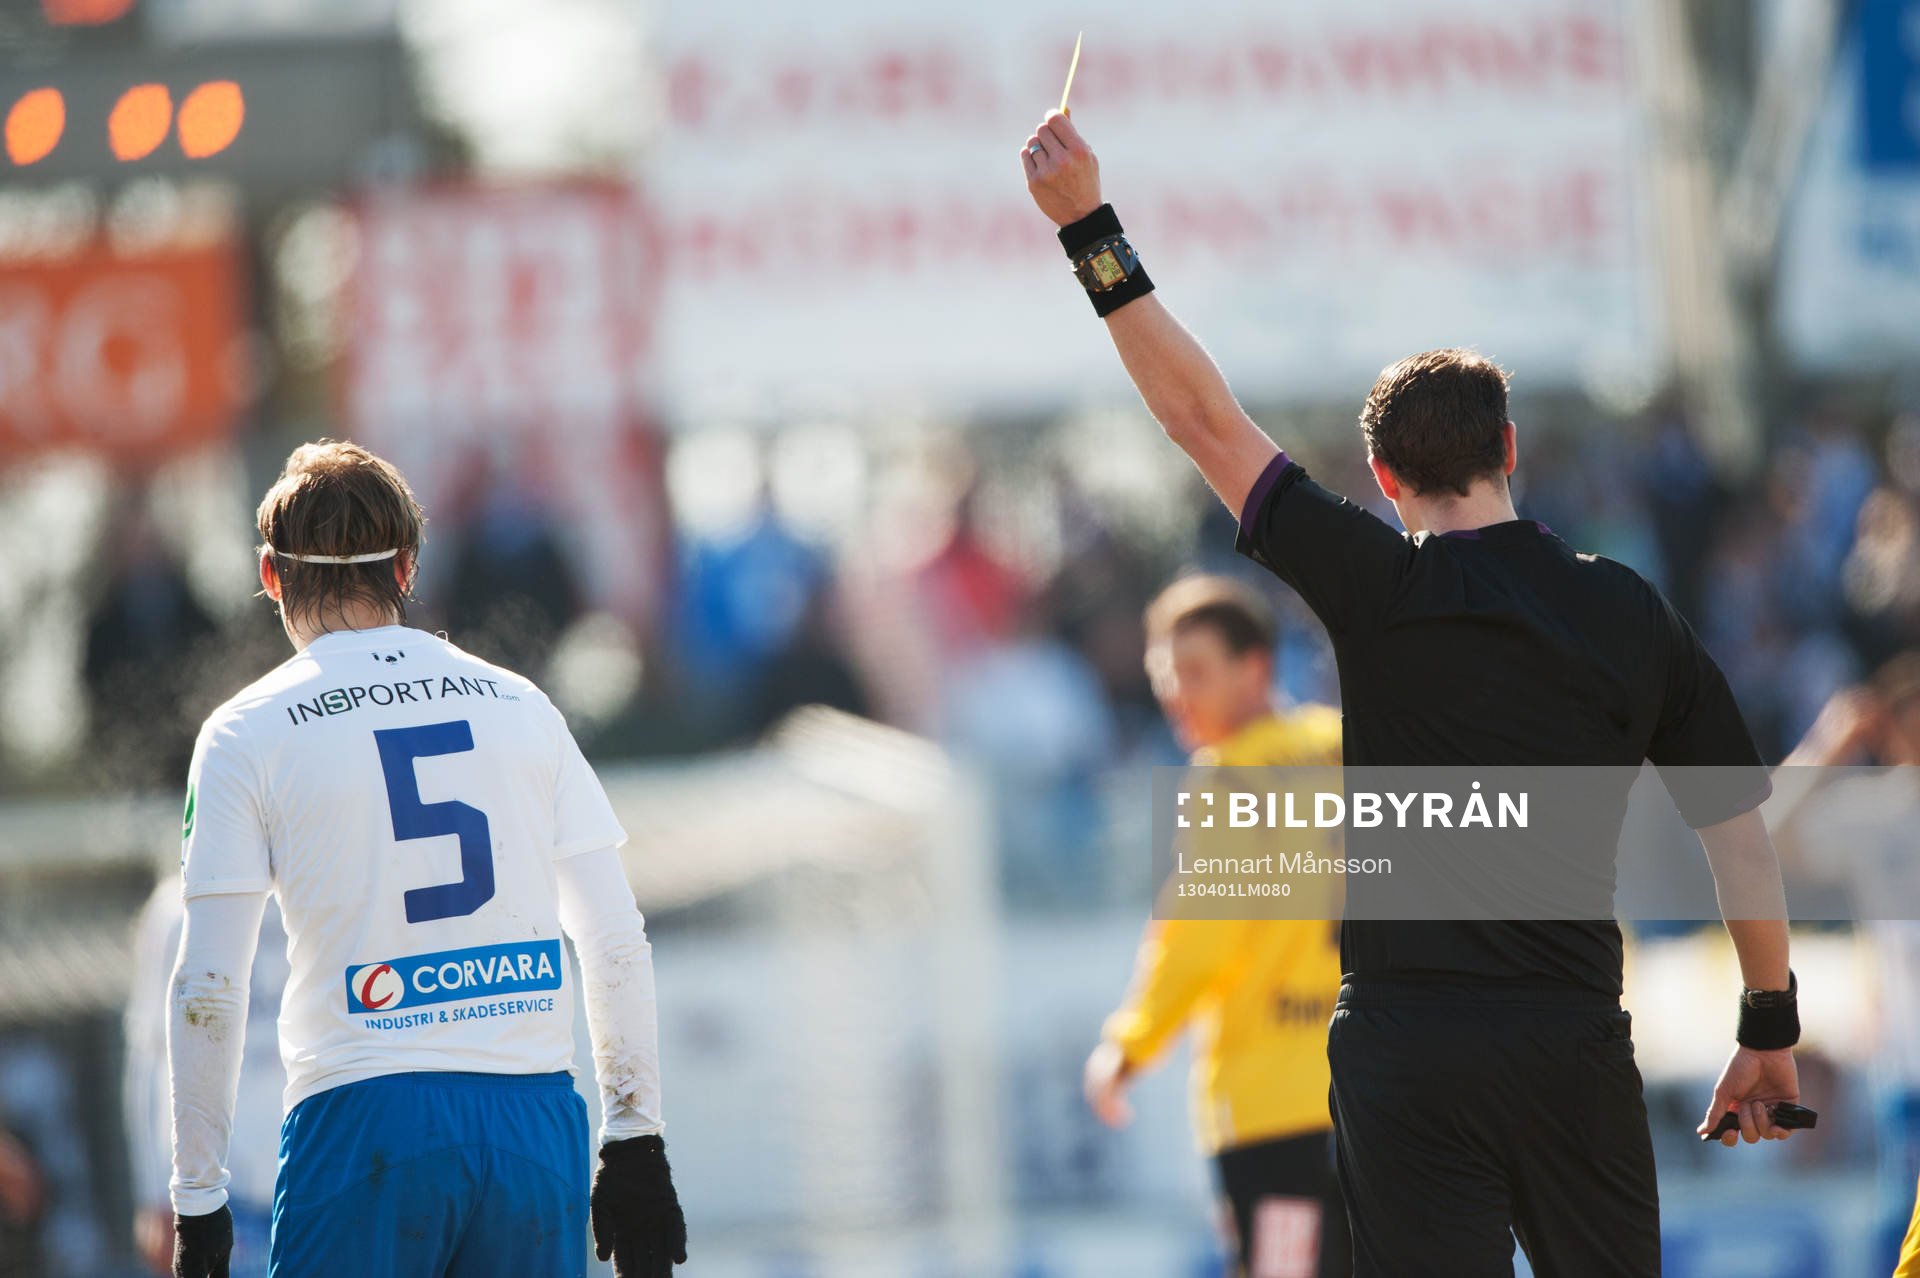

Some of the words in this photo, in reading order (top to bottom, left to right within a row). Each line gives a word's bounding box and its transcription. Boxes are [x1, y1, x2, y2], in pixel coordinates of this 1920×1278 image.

[373, 720, 495, 924] 5
[412, 952, 555, 994] CORVARA
[365, 1012, 433, 1030] INDUSTRI
[439, 1010, 449, 1023] &
[452, 998, 554, 1022] SKADESERVICE
